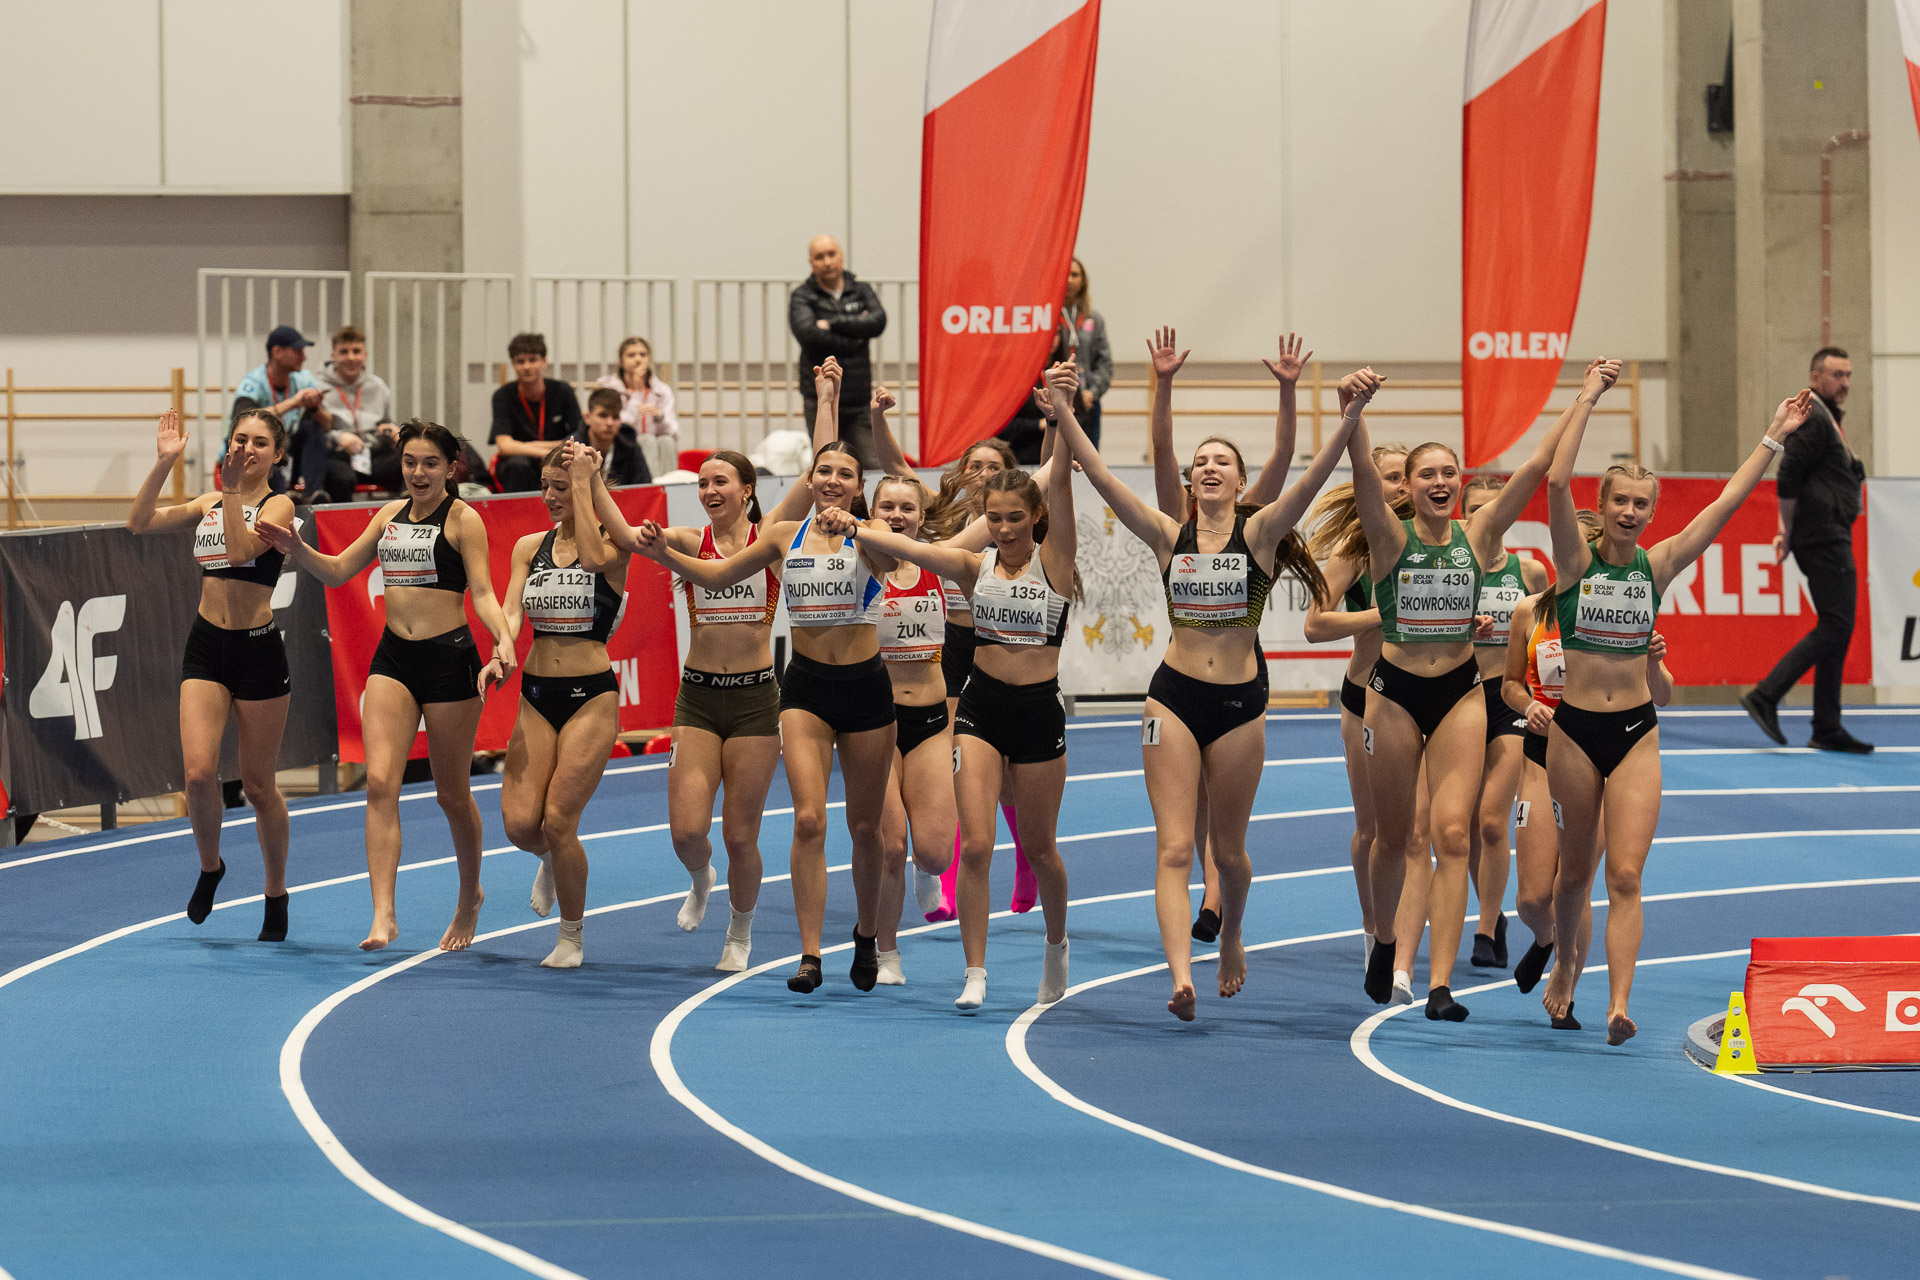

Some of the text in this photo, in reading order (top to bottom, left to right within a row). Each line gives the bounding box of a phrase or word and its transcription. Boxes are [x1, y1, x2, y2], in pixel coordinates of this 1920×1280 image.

[941, 303, 1052, 335] ORLEN
[1468, 331, 1568, 360] ORLEN
[410, 528, 433, 539] 721
[826, 558, 845, 571] 38
[1212, 557, 1241, 571] 842
[557, 572, 593, 586] 1121
[1442, 573, 1470, 586] 430
[1659, 543, 1818, 616] RLEN
[704, 584, 755, 600] SZOPA
[787, 581, 854, 598] RUDNICKA
[1010, 585, 1046, 600] 1354
[1172, 581, 1244, 597] RYGIELSKA
[1496, 591, 1519, 602] 437
[1623, 586, 1646, 599] 436
[524, 595, 591, 610] STASIERSKA
[914, 600, 939, 613] 671
[1400, 593, 1471, 611] SKOWROŃSKA
[975, 604, 1044, 626] ZNAJEWSKA
[1219, 610, 1236, 618] 2025
[1581, 605, 1650, 625] WARECKA
[249, 627, 268, 637] NIKE
[896, 621, 927, 639] ŻUK
[1586, 635, 1624, 646] WROCŁAW
[29, 594, 127, 740] 4F
[711, 673, 756, 687] NIKE
[1146, 718, 1157, 744] 1
[1363, 727, 1371, 752] 2
[1516, 802, 1524, 826] 4
[1552, 801, 1560, 824] 6
